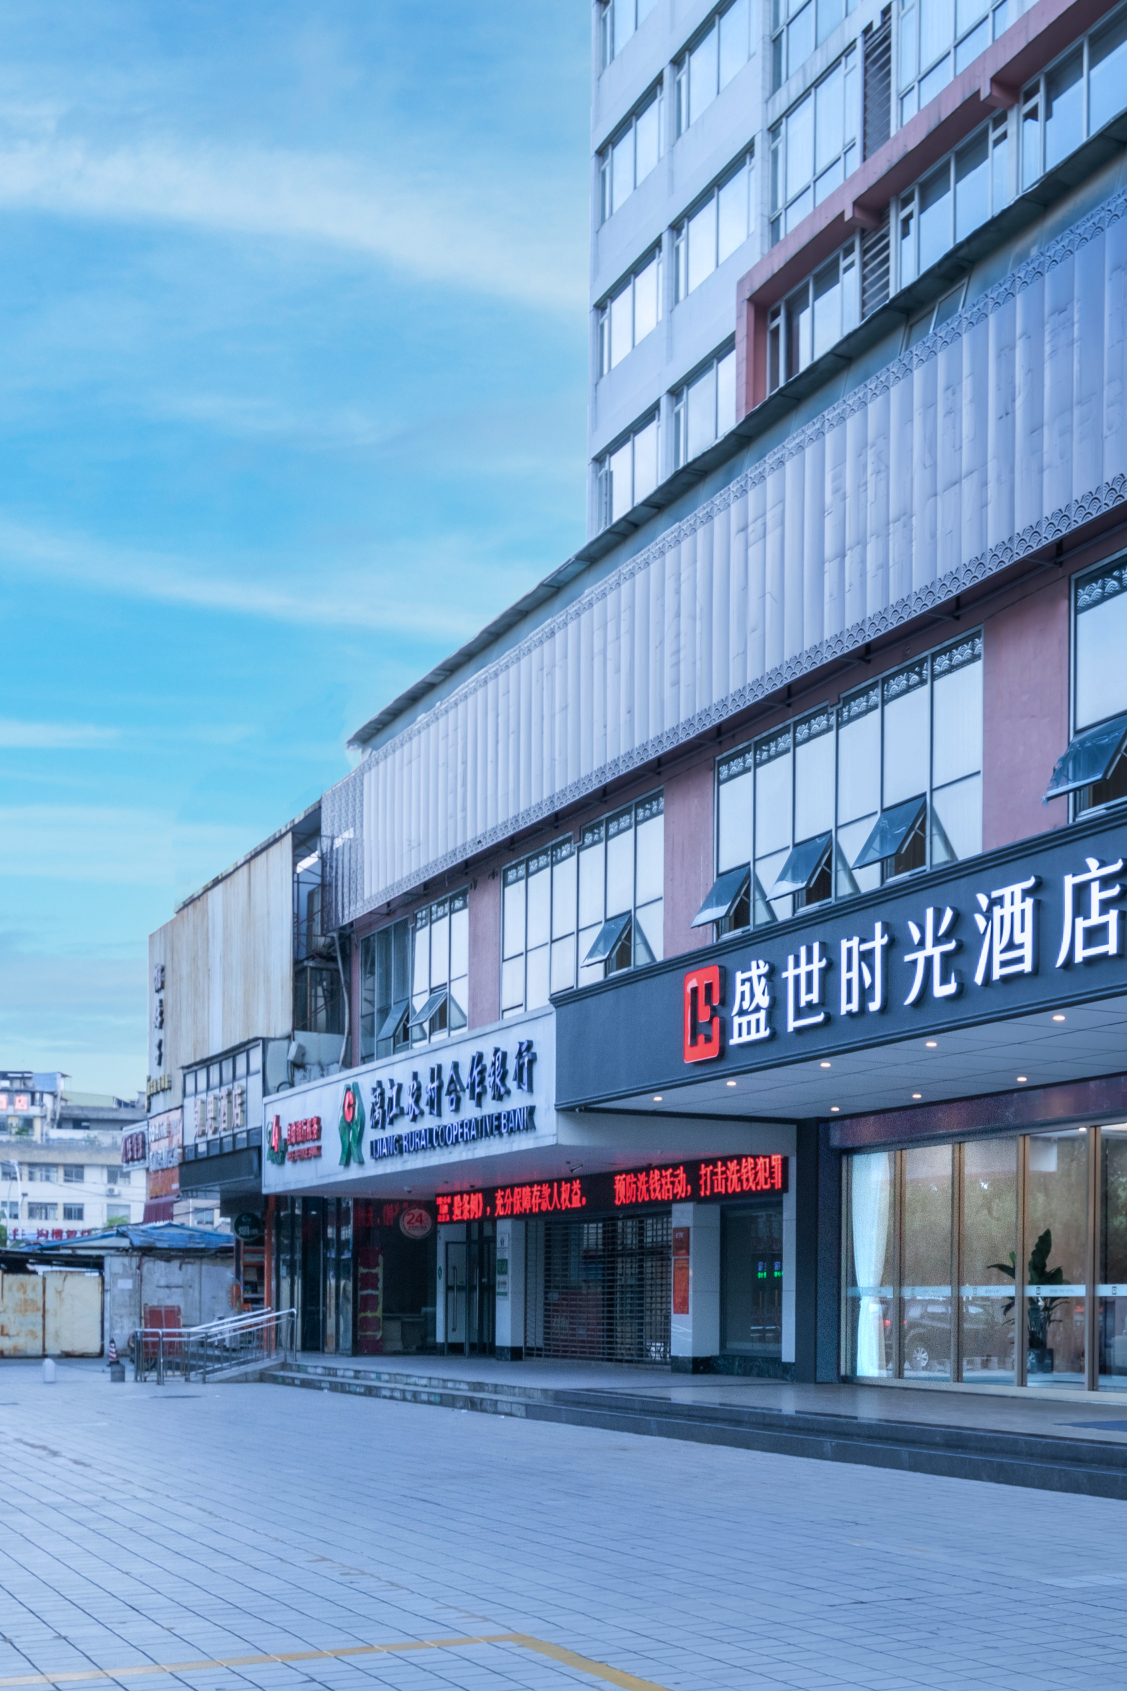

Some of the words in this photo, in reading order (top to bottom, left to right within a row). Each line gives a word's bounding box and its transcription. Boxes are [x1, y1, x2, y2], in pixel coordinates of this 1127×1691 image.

[728, 857, 1126, 1047] 盛世时光酒店
[370, 1040, 537, 1128] 漓江农村合作银行
[370, 1133, 400, 1159] LIJIANG
[402, 1128, 432, 1153] RURAL
[433, 1112, 499, 1147] COOPERATIVE
[500, 1105, 536, 1134] BANK
[406, 1212, 424, 1225] 24
